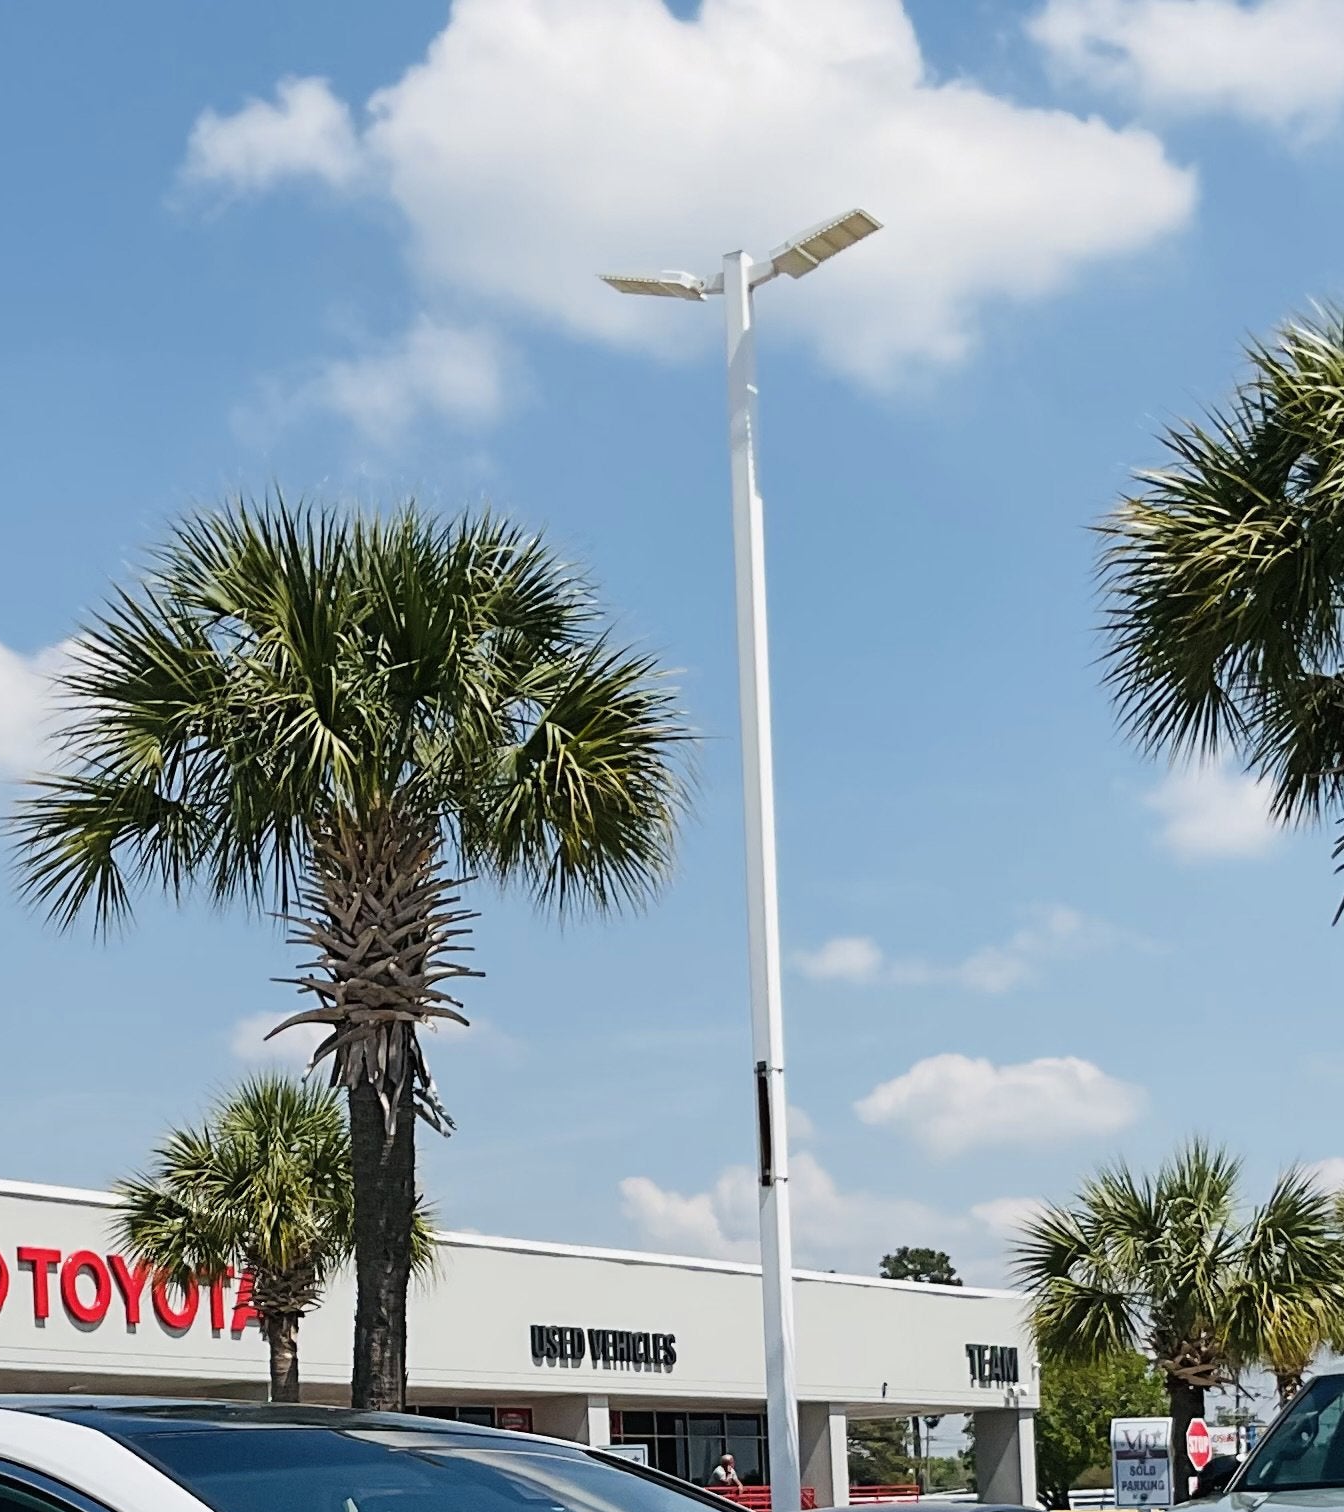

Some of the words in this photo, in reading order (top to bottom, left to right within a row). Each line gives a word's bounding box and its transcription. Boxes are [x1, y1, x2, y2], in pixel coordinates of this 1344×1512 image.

[530, 1325, 586, 1360] USED
[587, 1329, 677, 1366] VEHICLES
[965, 1343, 1019, 1383] TEAM
[1188, 1436, 1211, 1454] STOP
[1129, 1465, 1156, 1477] SOLD
[1121, 1480, 1165, 1492] PARKING
